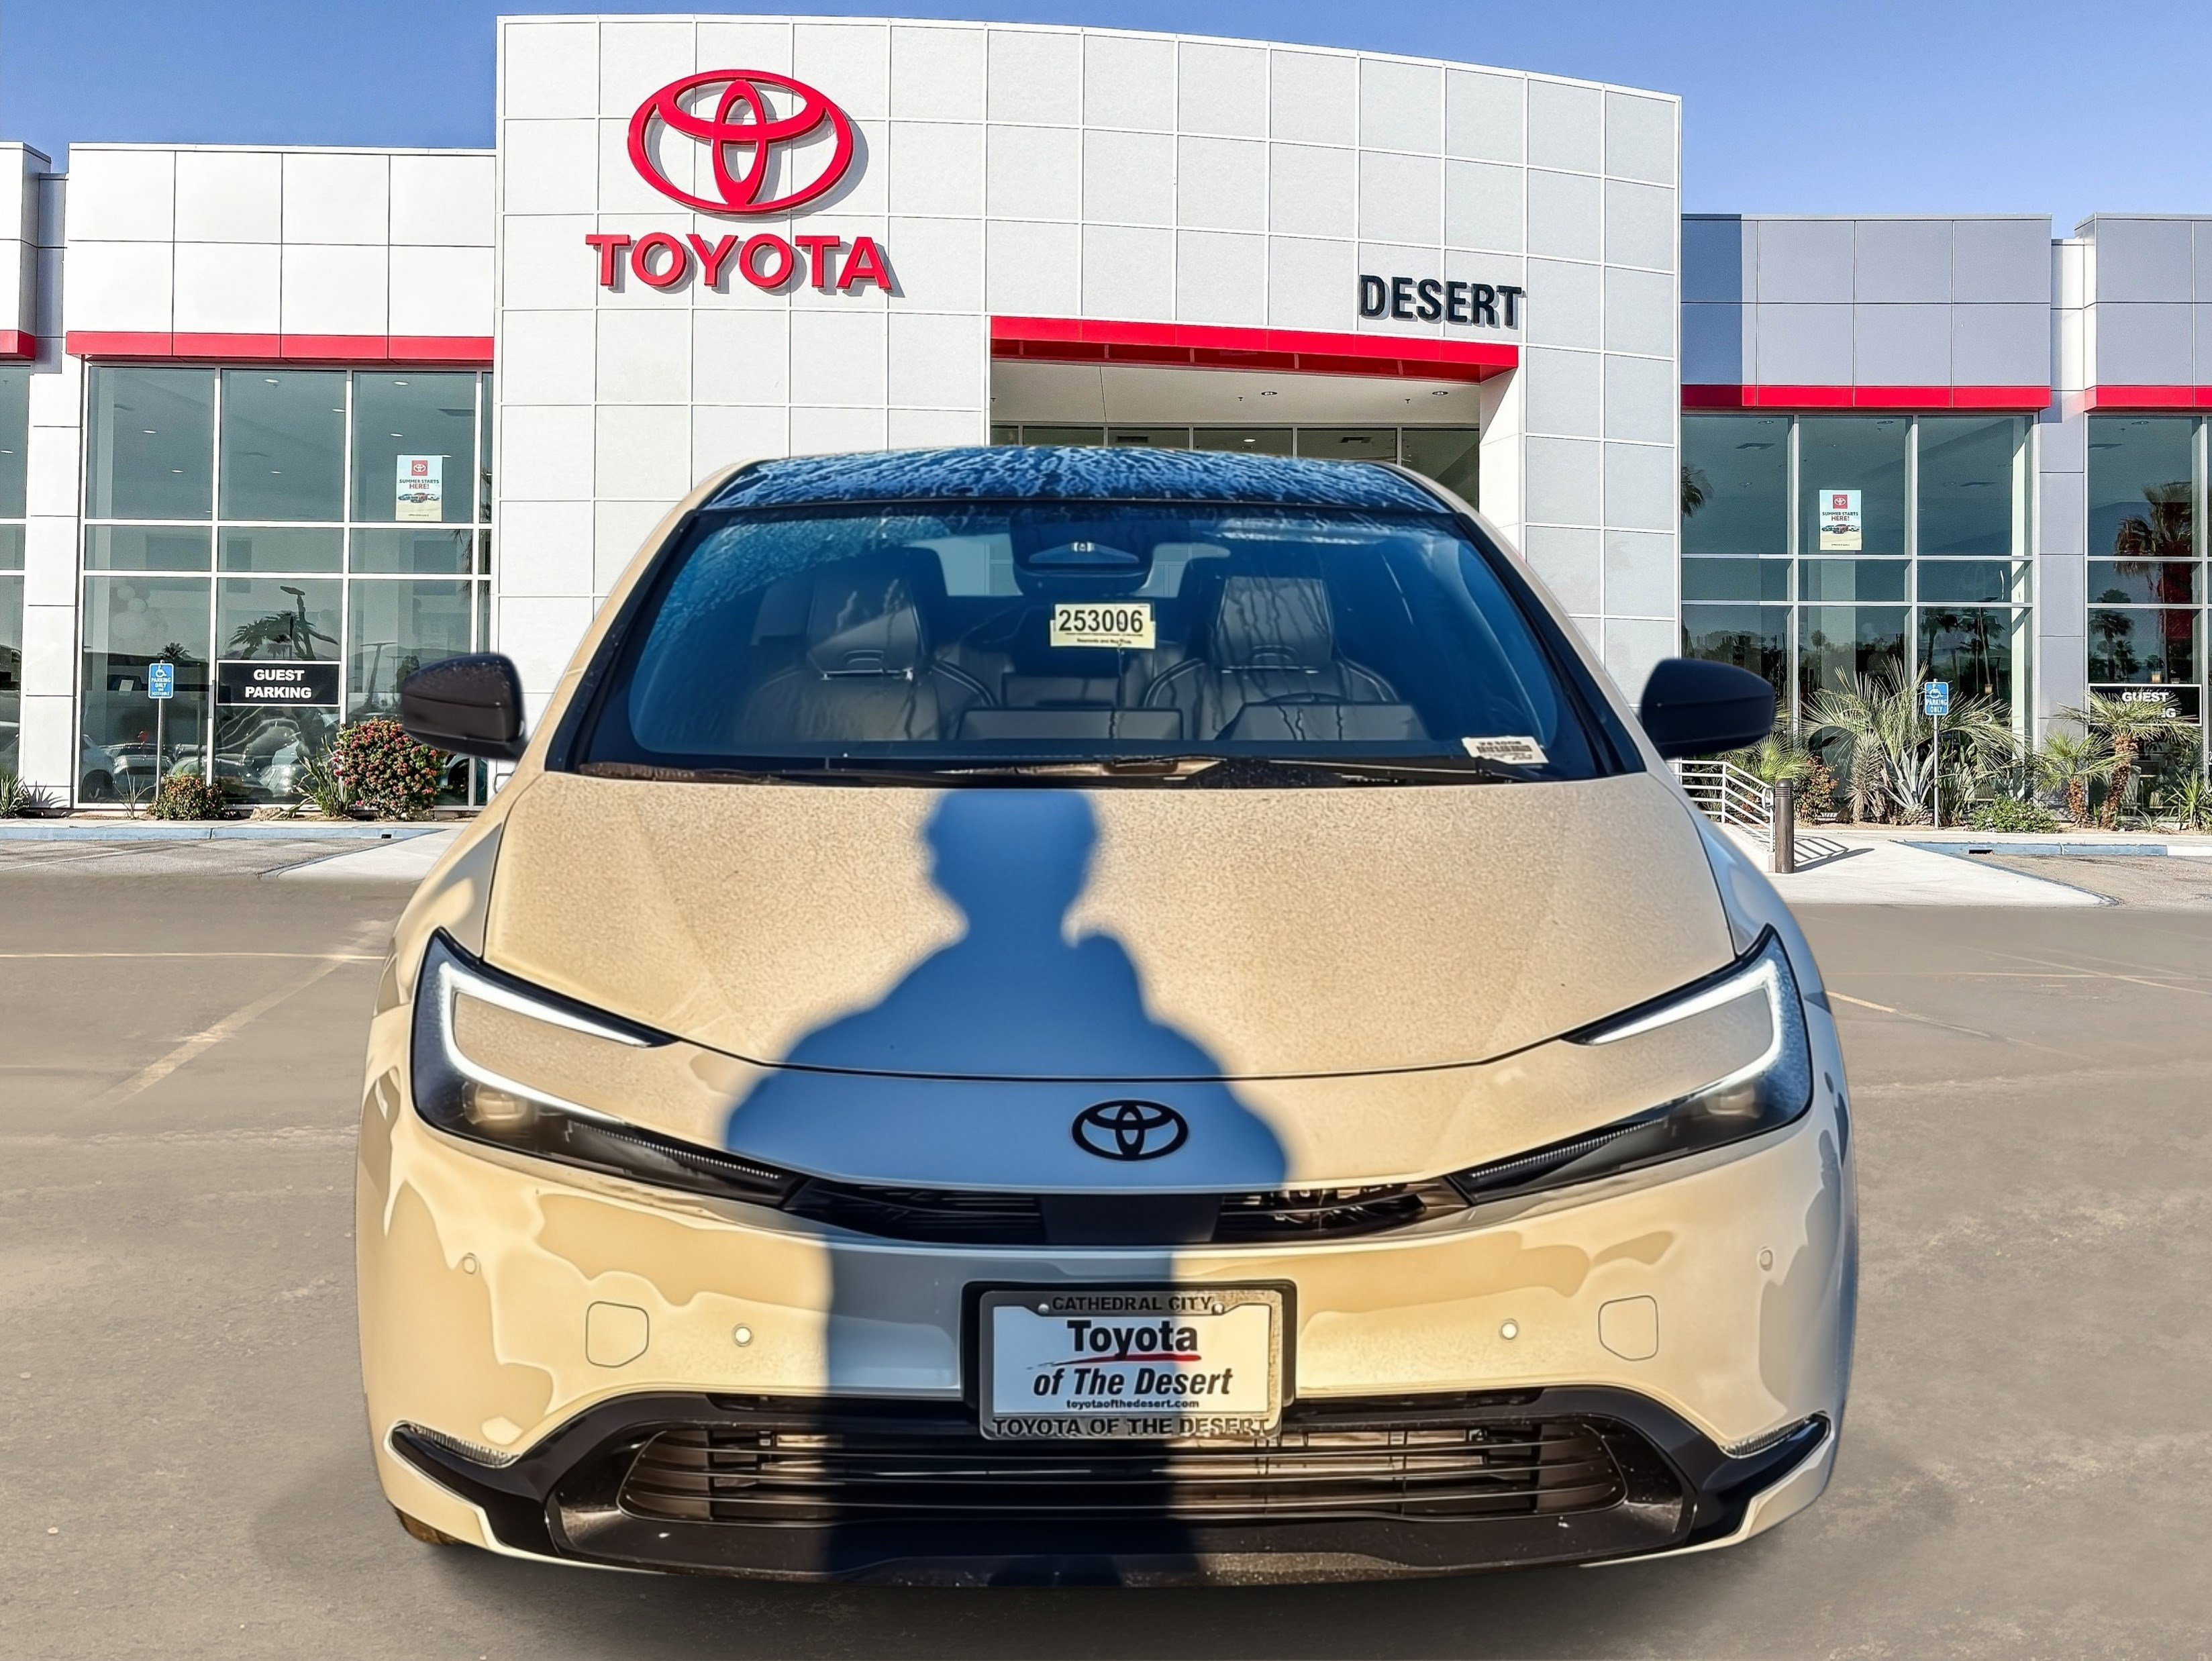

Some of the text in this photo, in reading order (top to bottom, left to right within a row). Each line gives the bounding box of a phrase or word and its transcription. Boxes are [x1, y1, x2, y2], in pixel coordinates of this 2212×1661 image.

[586, 232, 893, 291] TOYOTA
[1359, 274, 1522, 327] DESERT
[253, 669, 305, 681] GUEST
[245, 686, 311, 699] PARKING
[2121, 691, 2170, 703] GUEST
[1930, 705, 1944, 713] ONLY
[1052, 1296, 1212, 1311] CATHEDRAL CITY
[1067, 1319, 1199, 1360] Toyota
[1034, 1368, 1234, 1396] of The Desert
[1066, 1399, 1200, 1409] toyotaofthedesert.com
[993, 1417, 1270, 1436] TOYOTA OF THE DESERT
